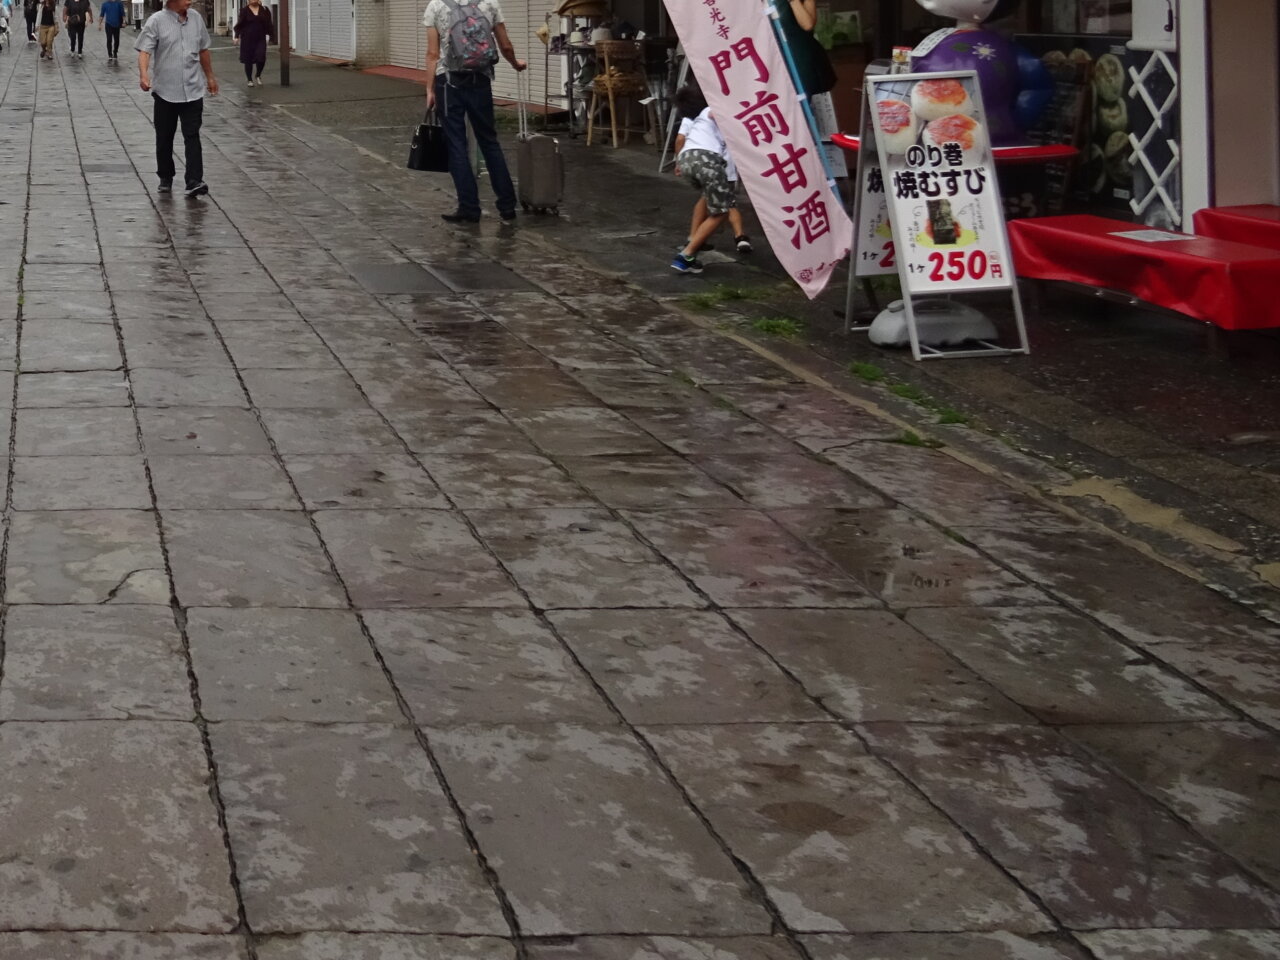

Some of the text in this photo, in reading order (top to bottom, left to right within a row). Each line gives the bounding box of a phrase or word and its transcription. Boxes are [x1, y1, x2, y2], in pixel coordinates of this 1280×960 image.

[708, 36, 832, 251] 門前甘酒
[906, 142, 964, 167] のり巻
[893, 166, 987, 199] 焼むすび
[927, 249, 988, 282] 250
